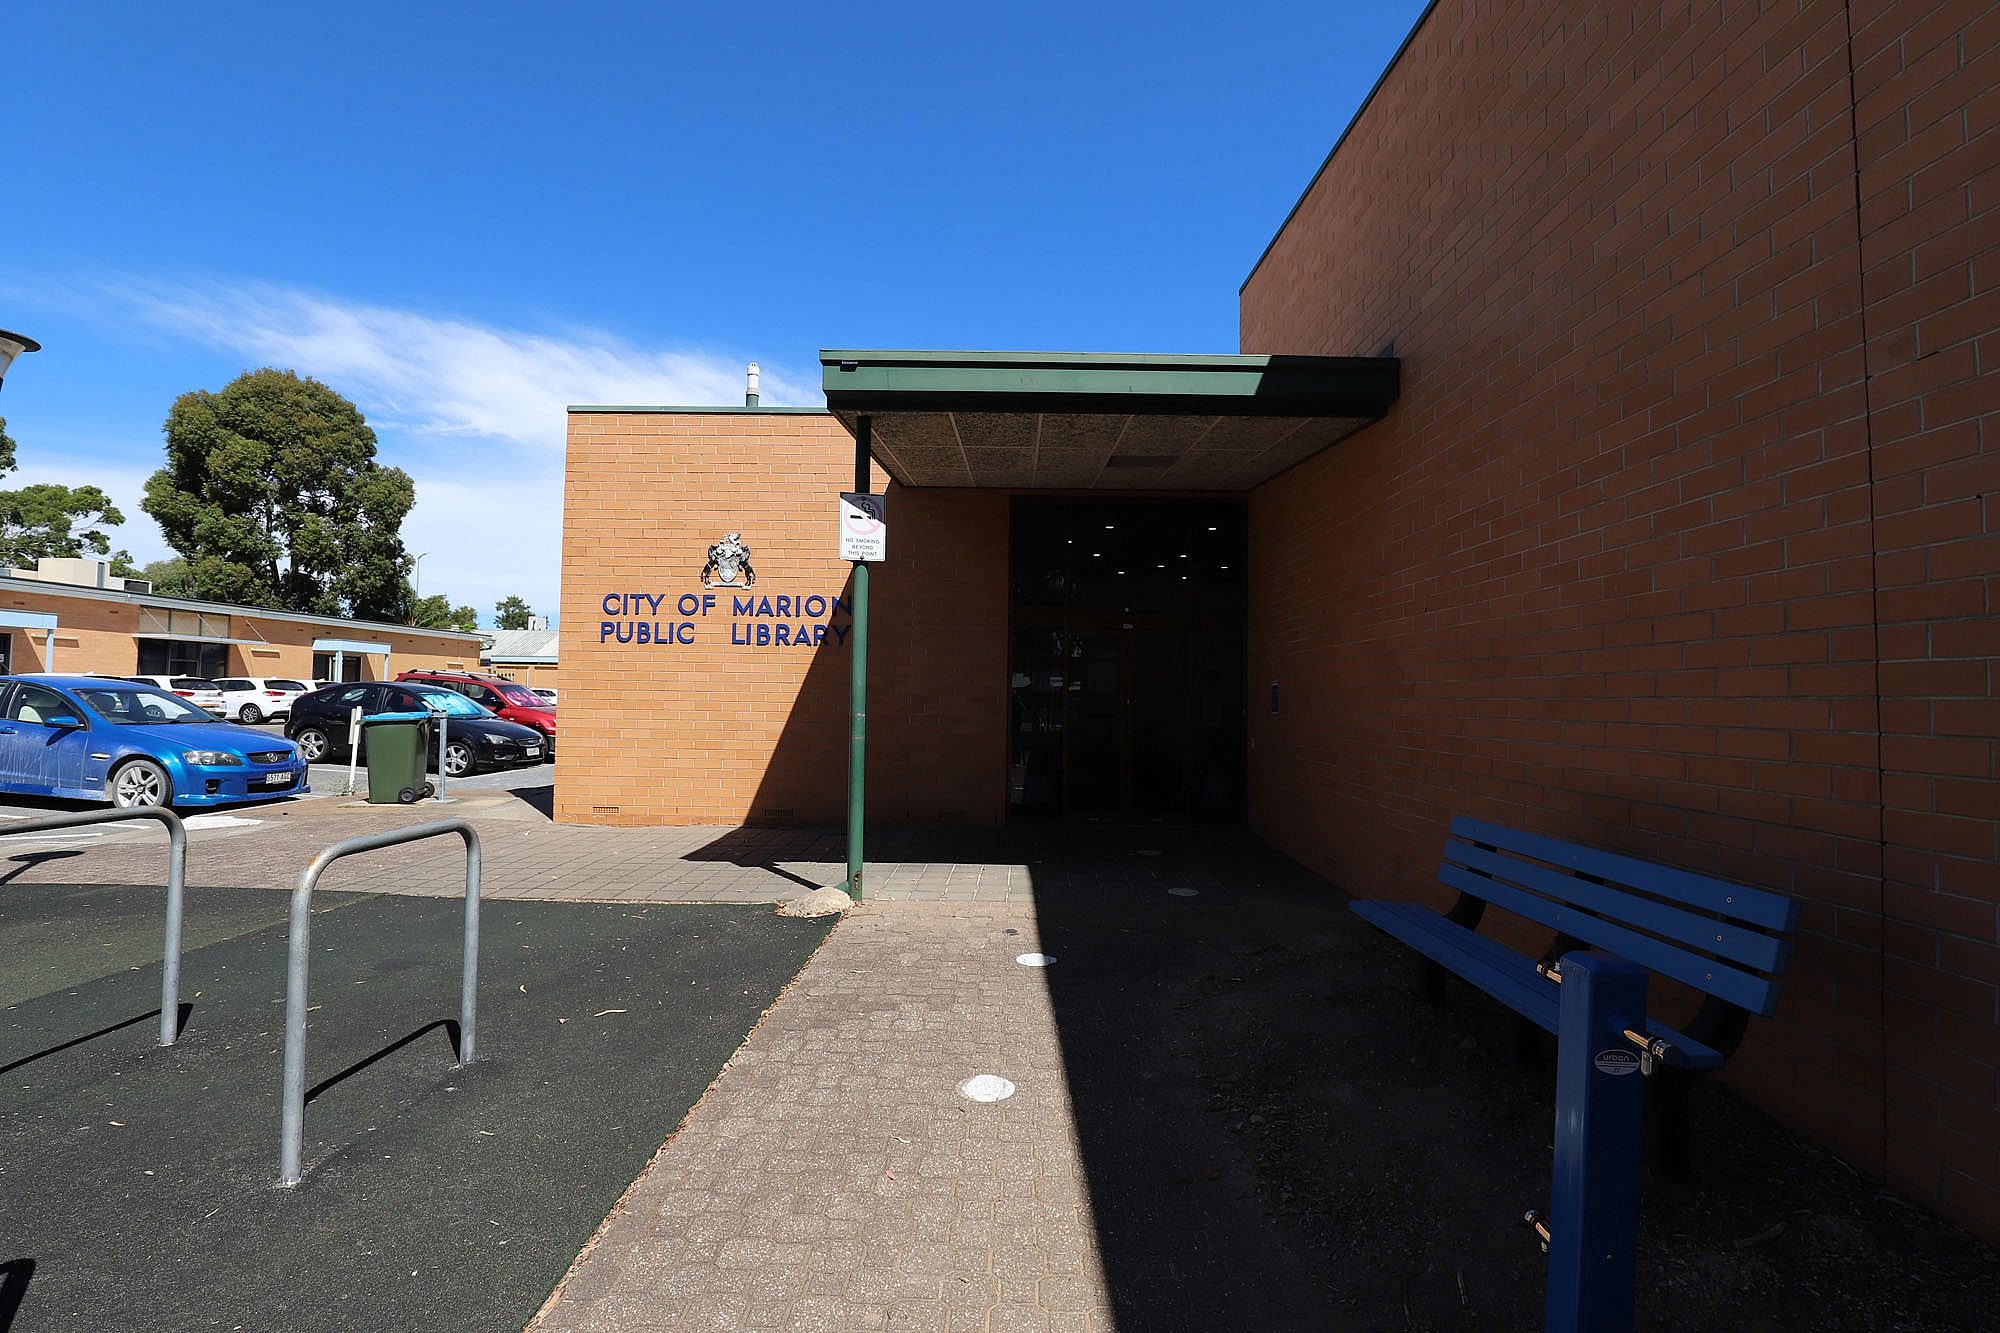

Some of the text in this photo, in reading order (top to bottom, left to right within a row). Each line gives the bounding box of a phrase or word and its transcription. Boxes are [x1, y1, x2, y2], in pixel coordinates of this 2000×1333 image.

[602, 593, 852, 618] CITY OF MARION
[600, 622, 852, 647] PUBLIC LIBRARY
